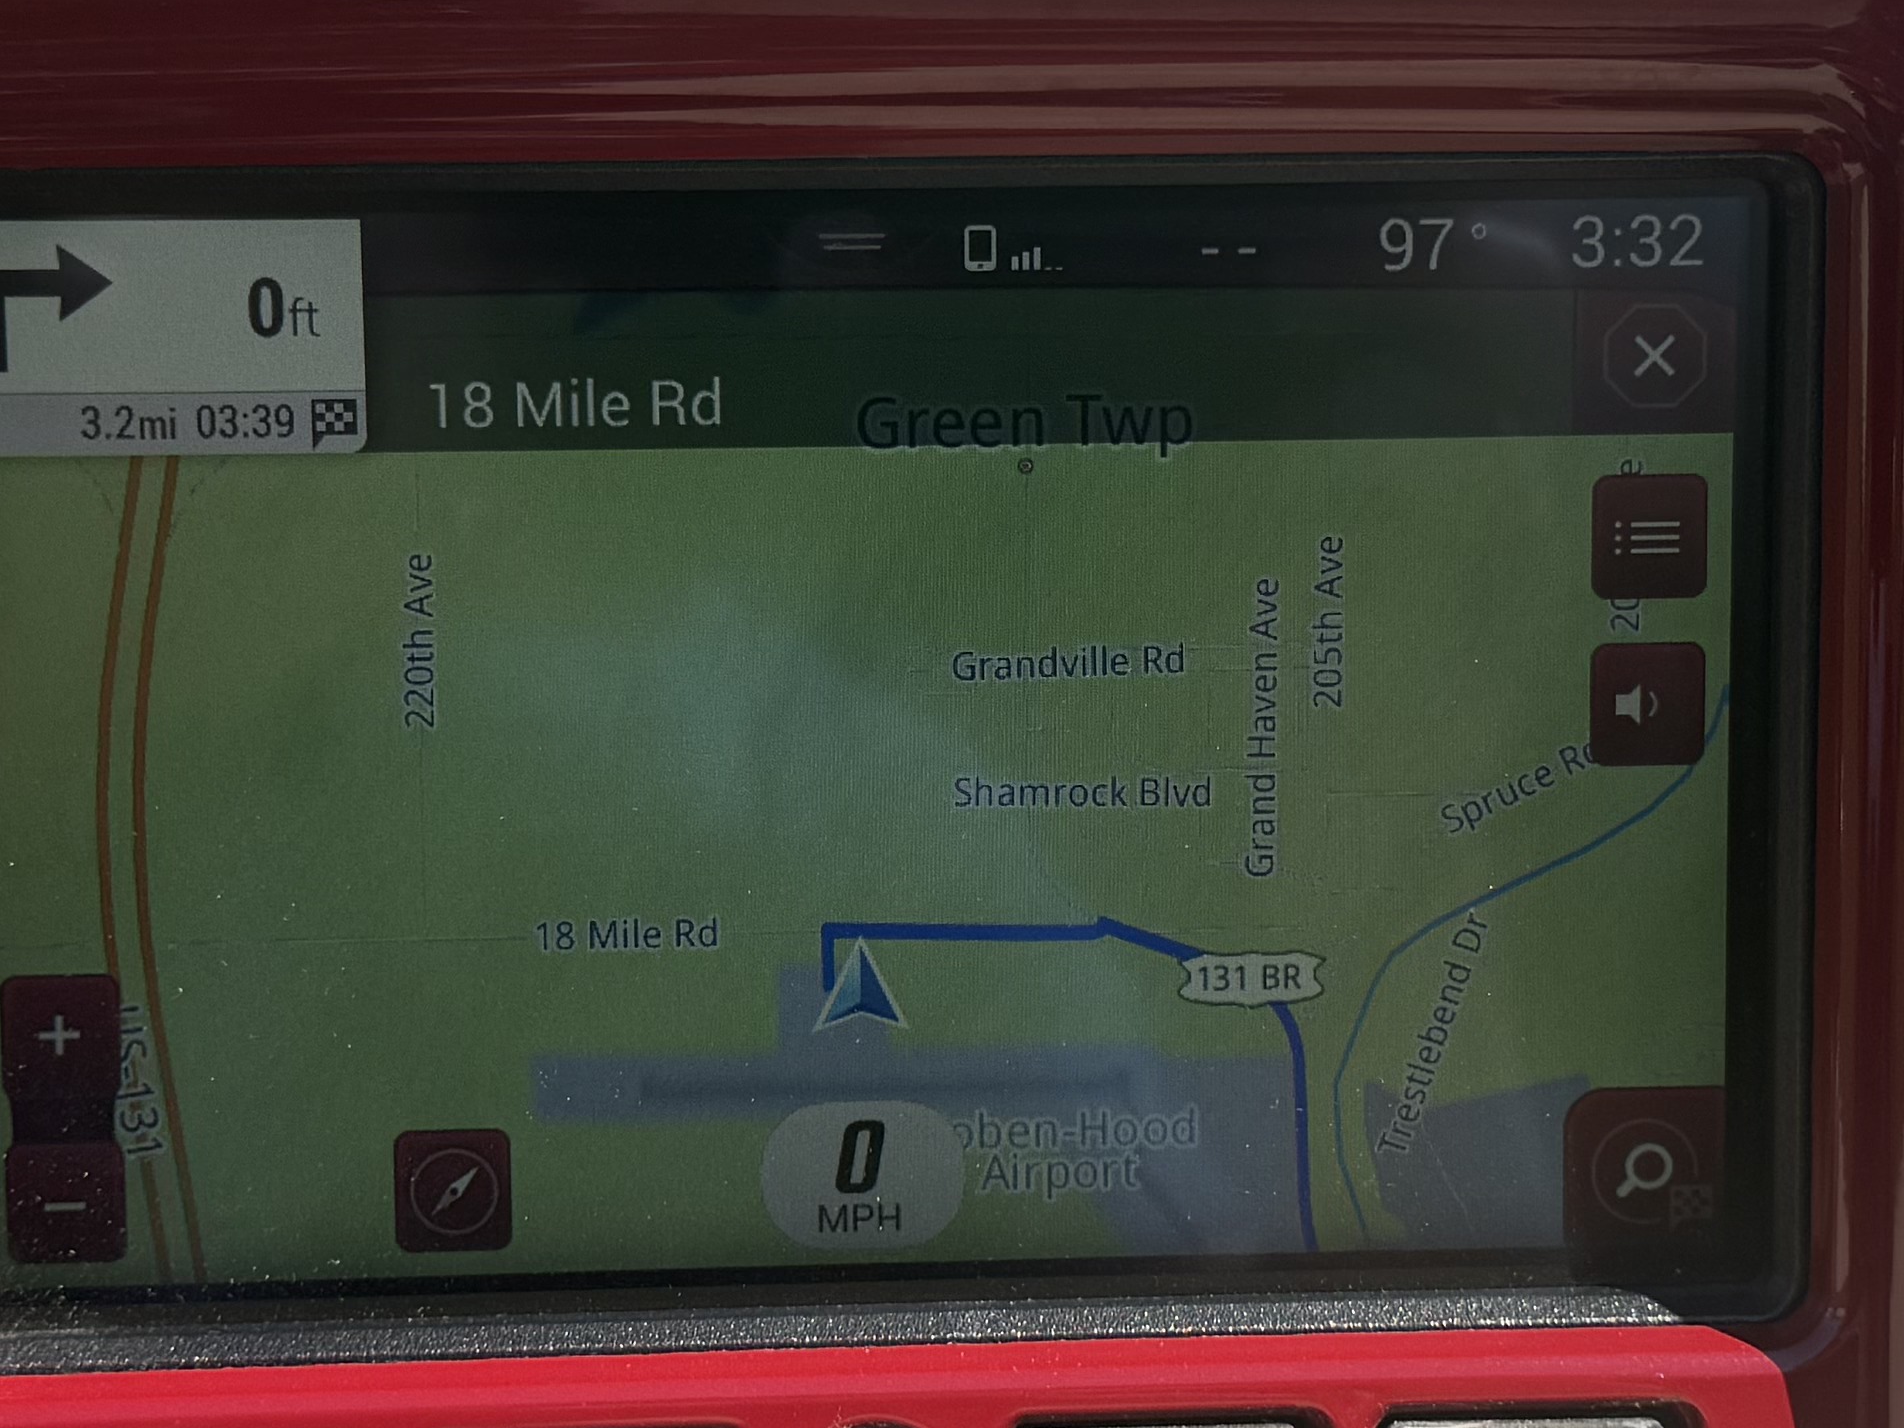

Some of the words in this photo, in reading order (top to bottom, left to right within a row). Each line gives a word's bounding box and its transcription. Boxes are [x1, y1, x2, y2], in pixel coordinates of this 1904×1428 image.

[1572, 215, 1704, 268] 3:32
[197, 404, 295, 441] 03:39
[430, 381, 495, 430] 18
[517, 378, 632, 429] Mile
[652, 377, 723, 427] Rd
[856, 397, 1044, 450] Green
[1067, 393, 1194, 457] Twp
[404, 553, 434, 618] Ave
[1312, 535, 1345, 600] Ave
[1248, 576, 1280, 642] Ave
[405, 629, 435, 729] 220th
[953, 644, 1129, 682] Grandville
[1144, 643, 1186, 675] Rd
[1312, 609, 1345, 708] 205th
[1245, 651, 1278, 759] Haven
[954, 775, 1129, 810] Shamrock
[1140, 774, 1214, 810] Blvd
[1441, 765, 1558, 835] Spruce
[1244, 772, 1278, 878] Grand
[535, 921, 574, 952] 18
[588, 918, 662, 951] Mile
[673, 917, 720, 950] Rd
[1198, 965, 1248, 992] 131
[1260, 964, 1303, 991] BR
[1376, 960, 1473, 1154] Trestlebend
[1454, 909, 1489, 954] Dr
[834, 1119, 886, 1194] 0
[953, 1108, 1198, 1149] oben-Hood
[980, 1152, 1140, 1199] Airport
[818, 1204, 902, 1233] MPH
